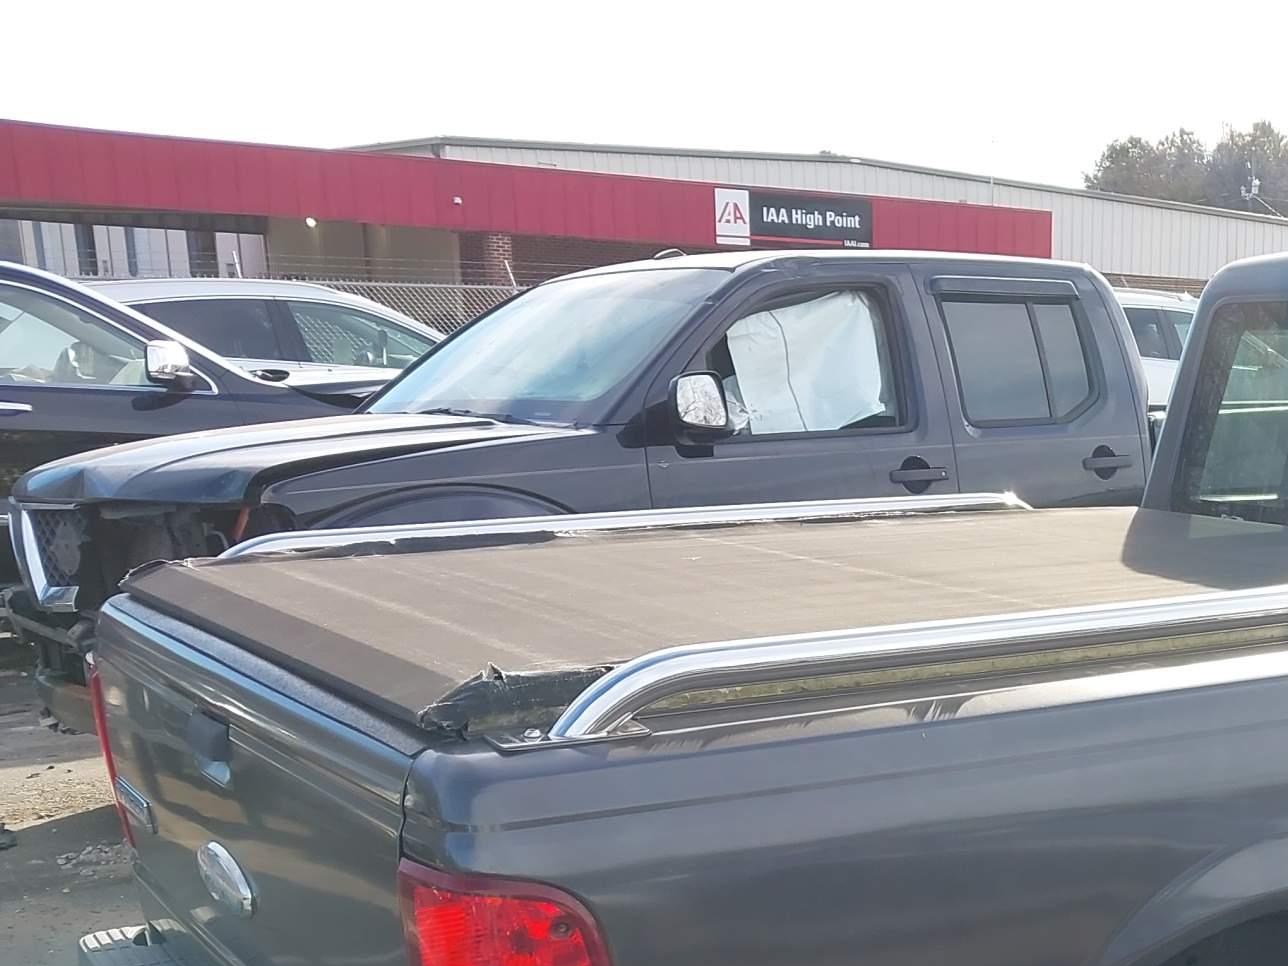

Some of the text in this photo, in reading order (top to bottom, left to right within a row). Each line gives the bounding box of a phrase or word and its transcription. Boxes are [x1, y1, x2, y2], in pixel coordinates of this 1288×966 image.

[762, 206, 861, 229] IAA High Point
